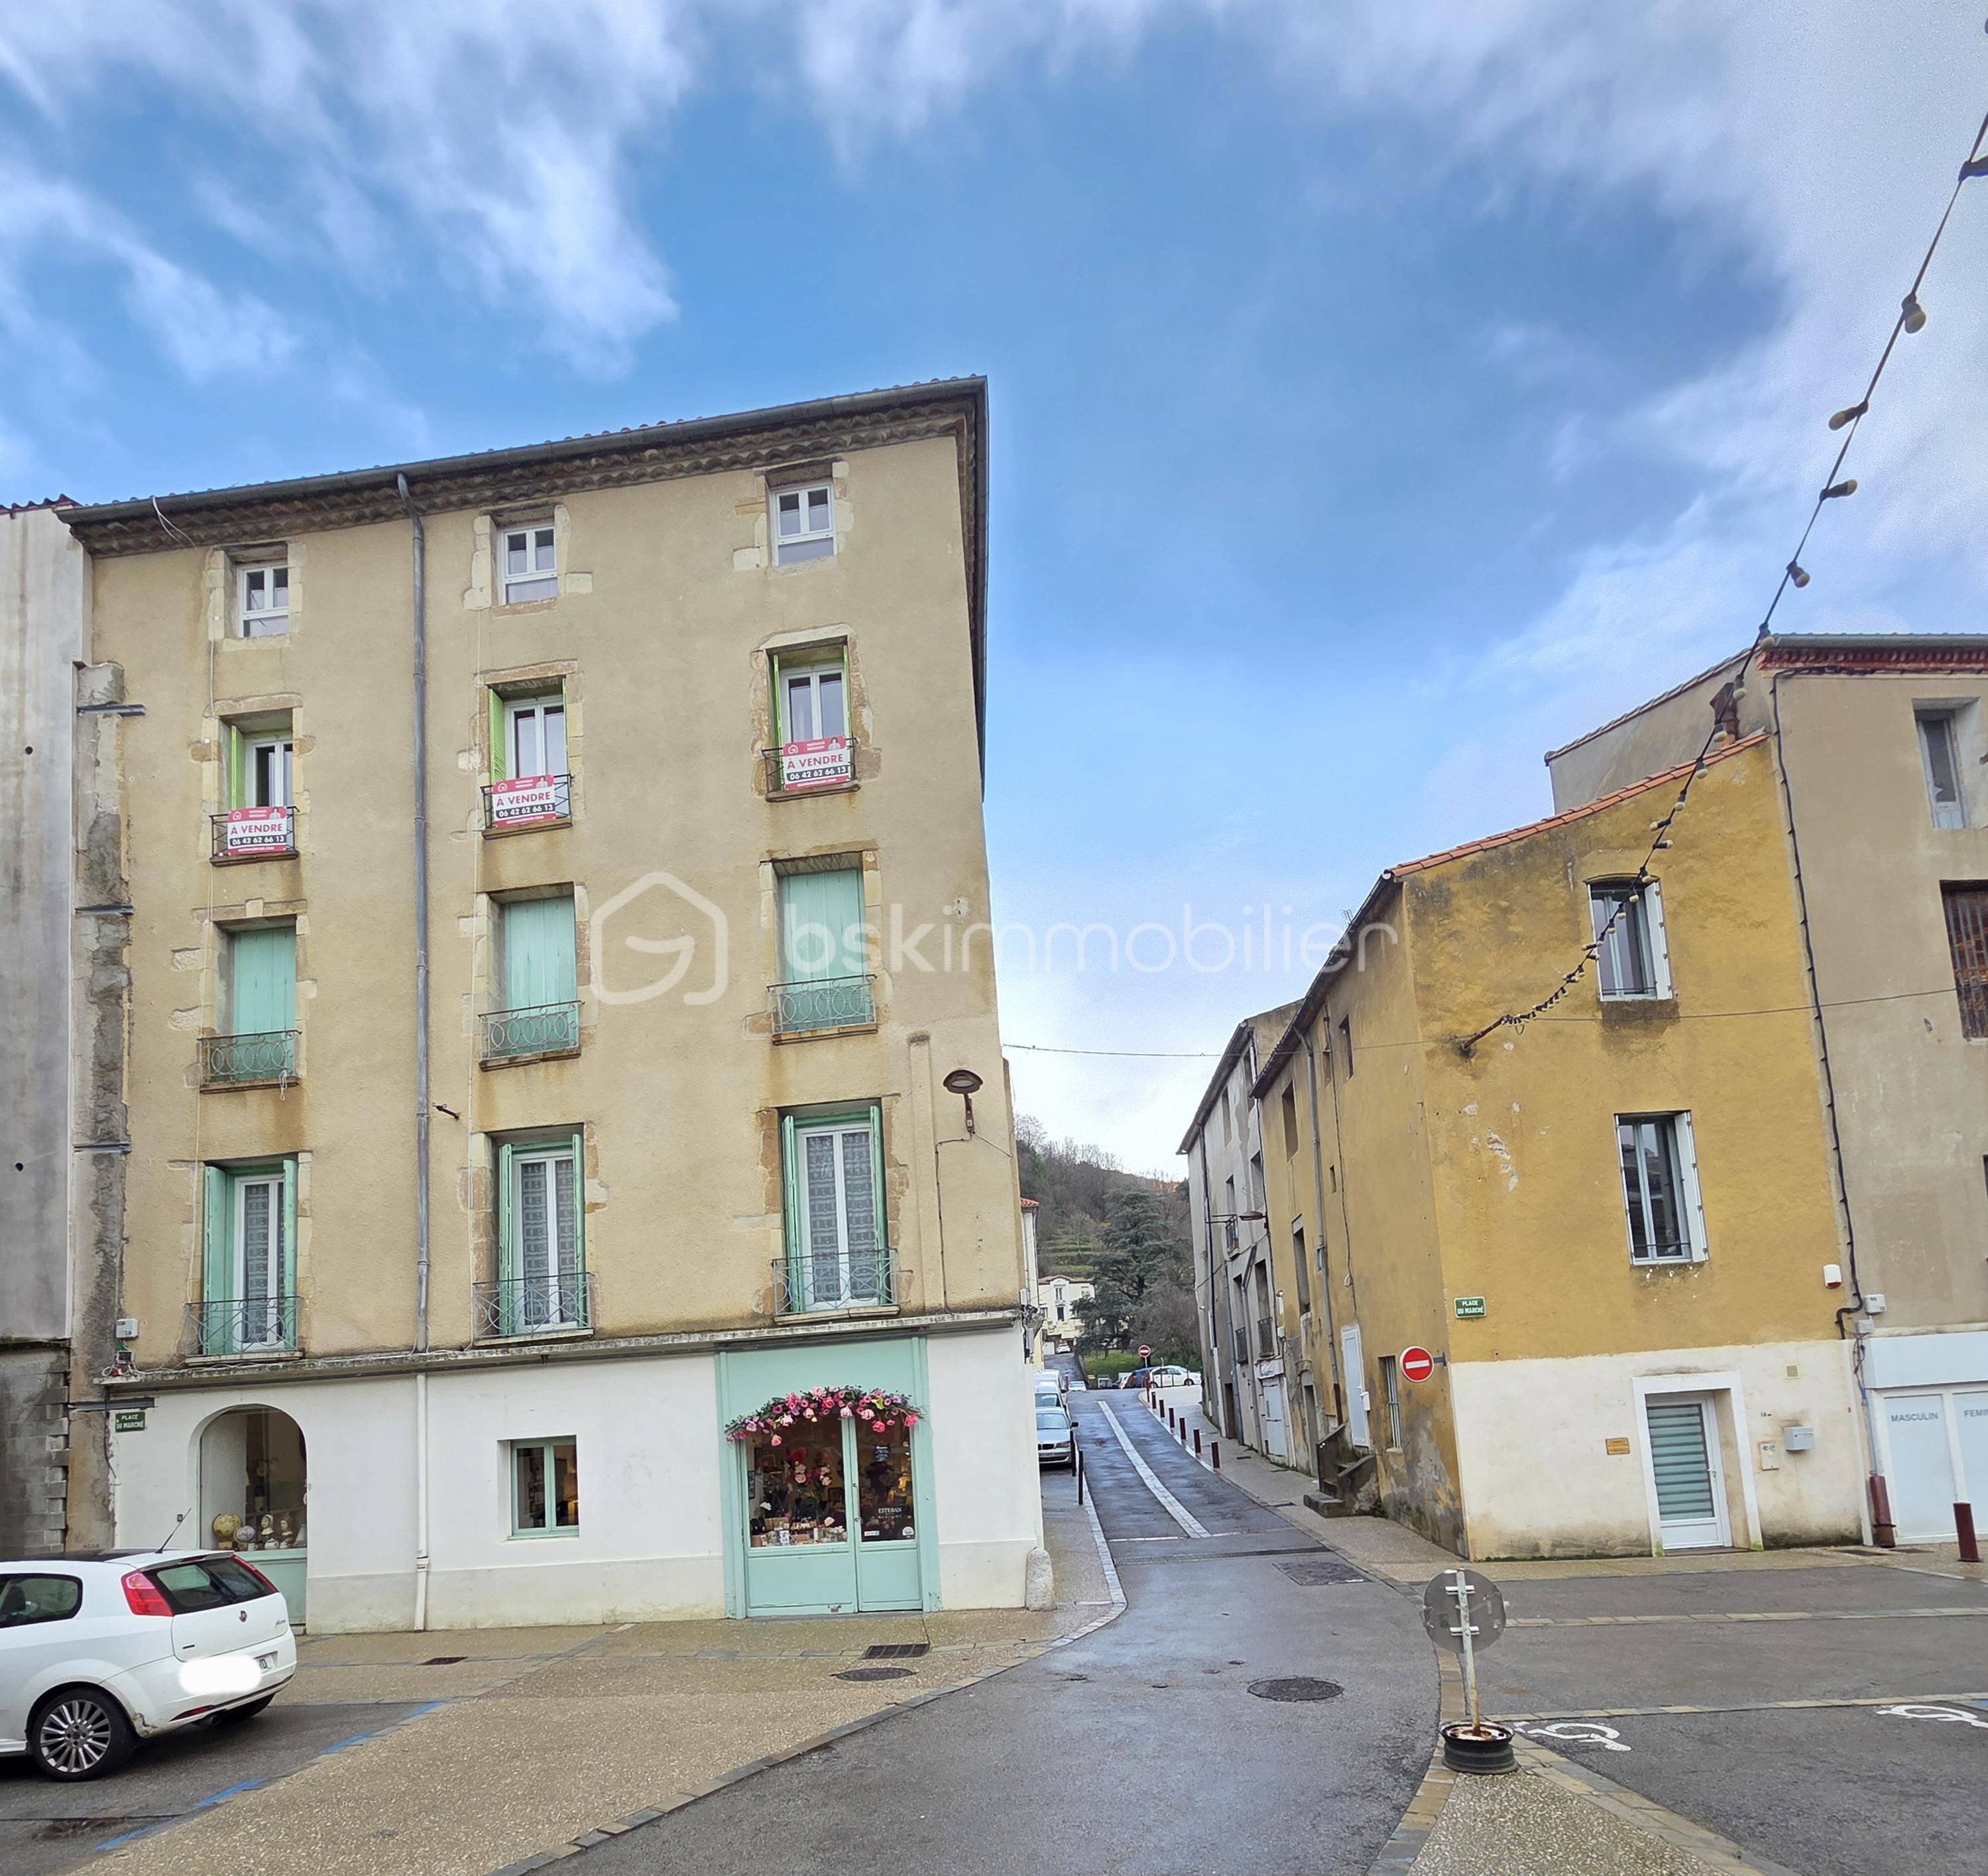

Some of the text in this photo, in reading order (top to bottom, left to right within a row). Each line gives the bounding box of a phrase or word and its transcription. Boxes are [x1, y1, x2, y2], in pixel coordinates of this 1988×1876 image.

[787, 754, 844, 770] À VENDRE
[497, 791, 551, 807] À VENDRE
[230, 823, 283, 835] À VENDRE
[1891, 1412, 1939, 1423] MASCULIN
